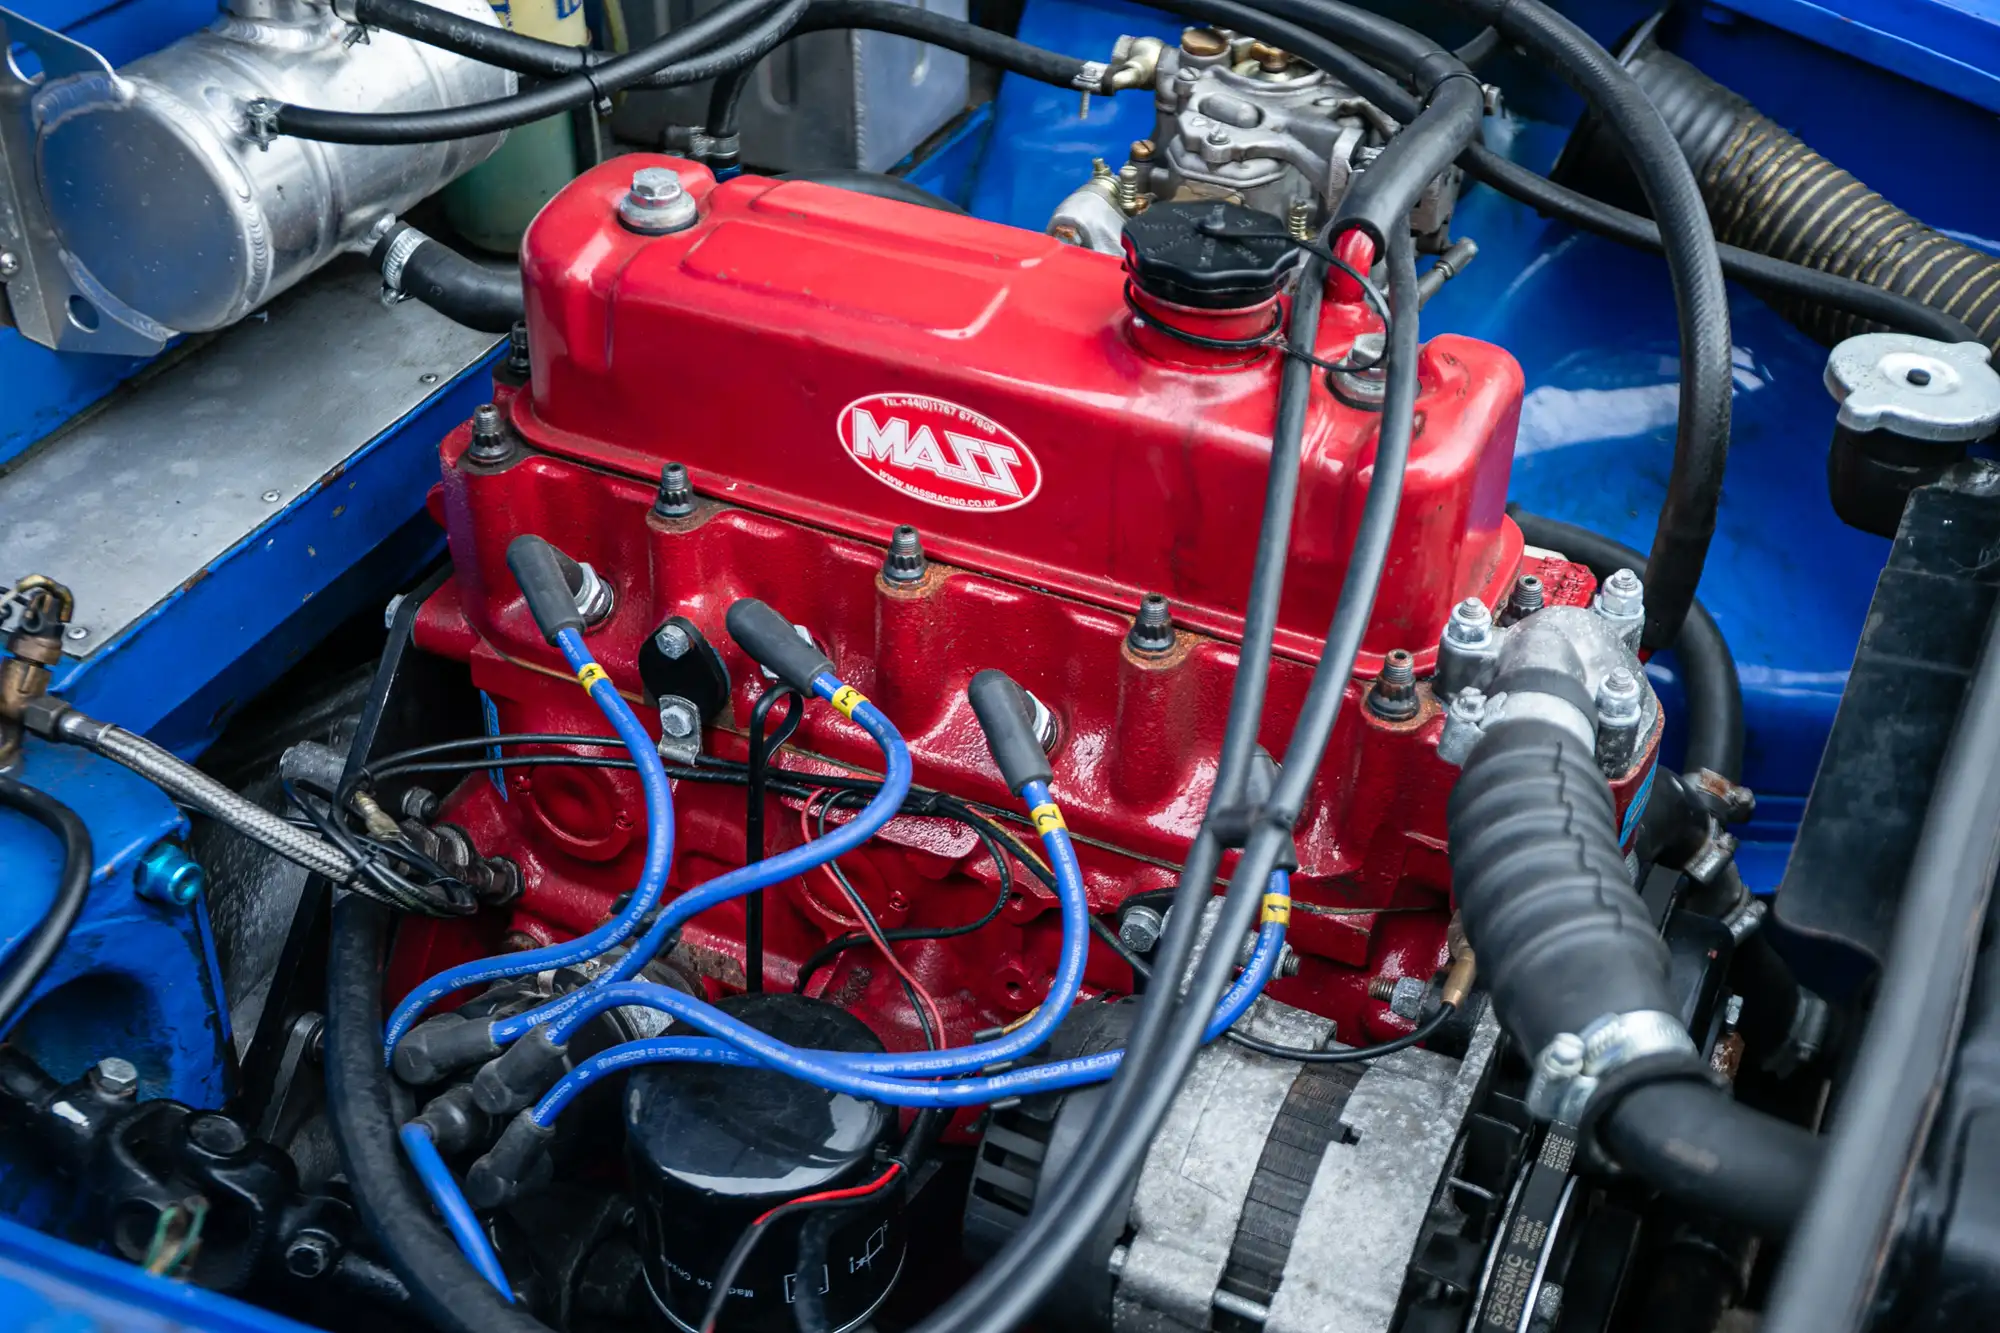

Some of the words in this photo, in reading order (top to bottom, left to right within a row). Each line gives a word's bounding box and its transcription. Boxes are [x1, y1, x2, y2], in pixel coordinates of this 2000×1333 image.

[958, 410, 996, 435] 677800
[852, 406, 1023, 499] MASS
[878, 469, 998, 508] WWW.MASSRACING.CO.UK
[840, 689, 860, 707] 3
[1037, 809, 1059, 826] 2
[1267, 904, 1288, 913] 1
[451, 969, 502, 988] MAGNECOR
[631, 883, 658, 920] CABLE
[1244, 949, 1268, 983] CABLE
[527, 995, 577, 1026] MAGNECOR
[596, 1048, 646, 1070] MAGNECOR
[987, 1063, 1069, 1089] MAGNECOR
[1072, 1051, 1125, 1072] ELECTR
[727, 1287, 754, 1298] Mad
[1489, 1253, 1523, 1325] 6265MC
